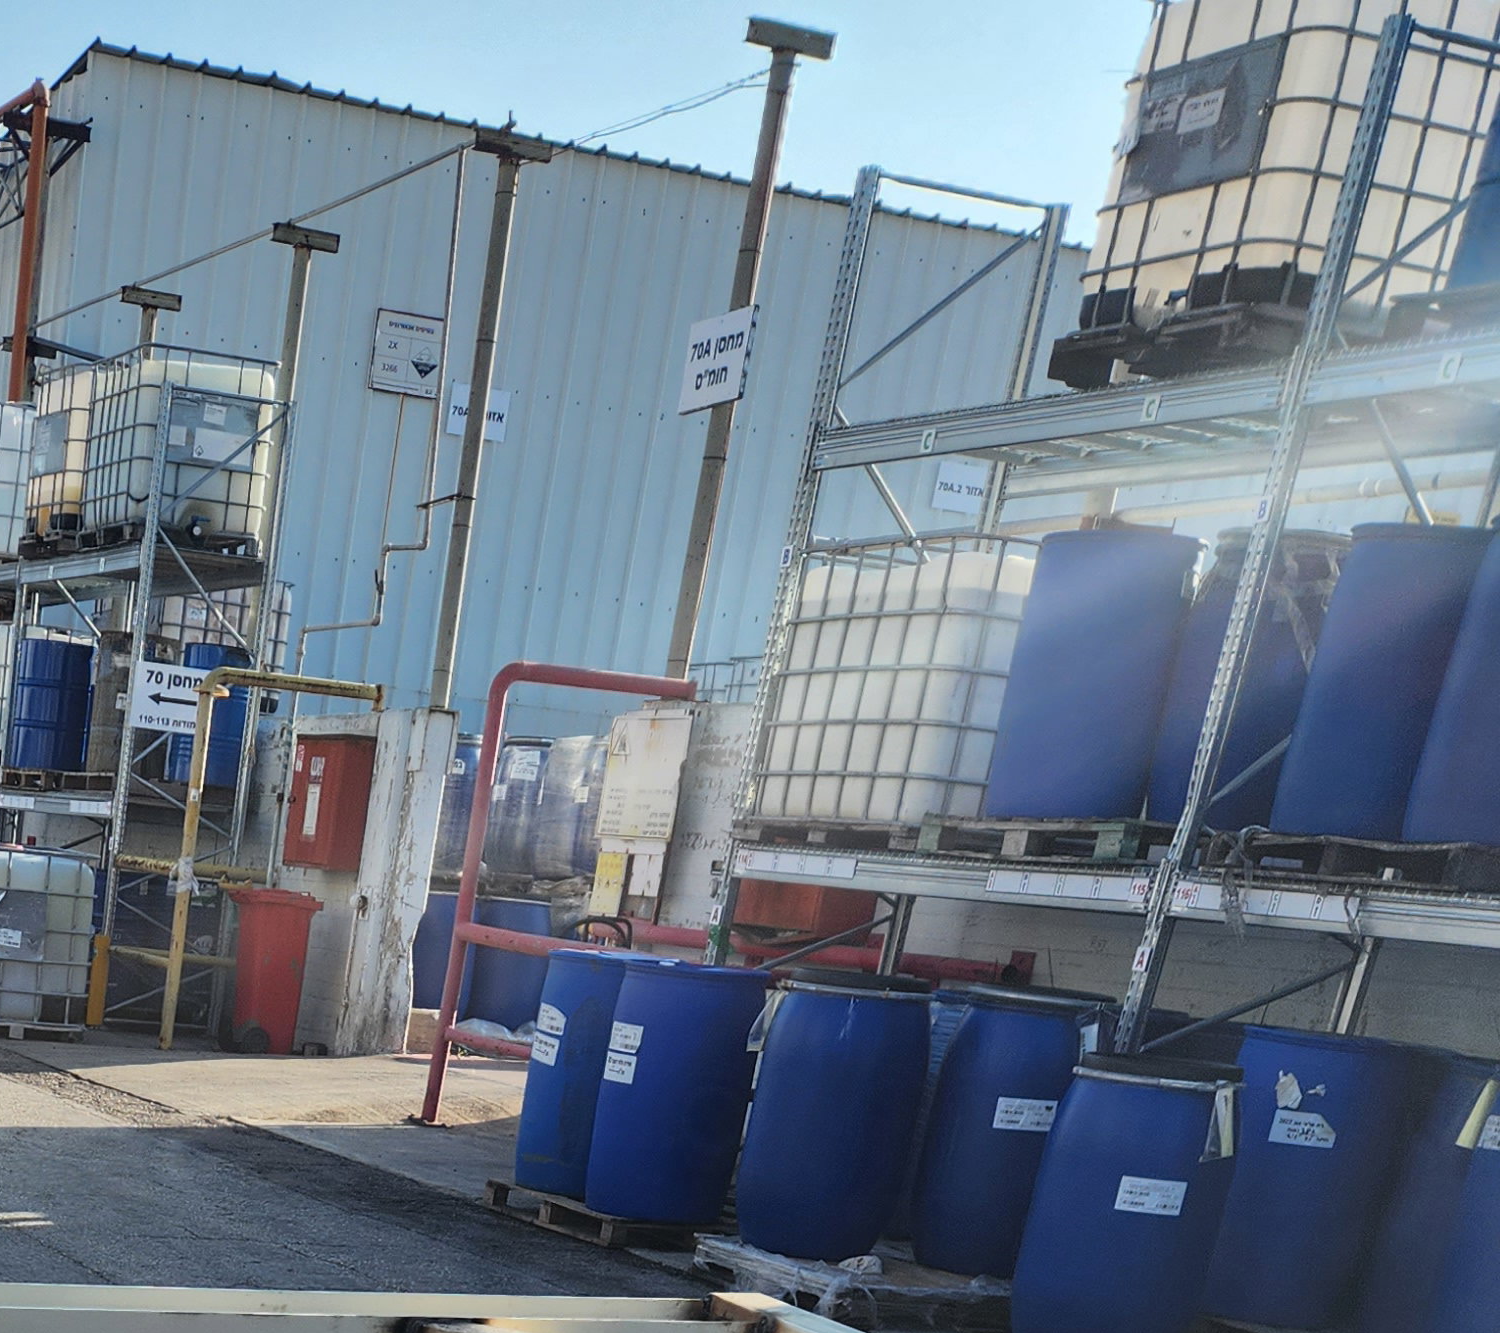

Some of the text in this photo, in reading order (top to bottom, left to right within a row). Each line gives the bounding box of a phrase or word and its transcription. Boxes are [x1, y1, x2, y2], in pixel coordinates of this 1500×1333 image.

[388, 340, 399, 350] 2X
[690, 331, 745, 362] מחסן 70A
[485, 410, 505, 423] אזו
[1145, 399, 1156, 418] C
[923, 431, 933, 450] C
[938, 481, 984, 497] אזור 70A.2
[1257, 499, 1268, 520] B
[782, 548, 790, 565] B
[146, 670, 204, 689] מחסן 70
[1132, 883, 1147, 896] 115
[711, 907, 719, 922] A
[1135, 950, 1145, 968] A
